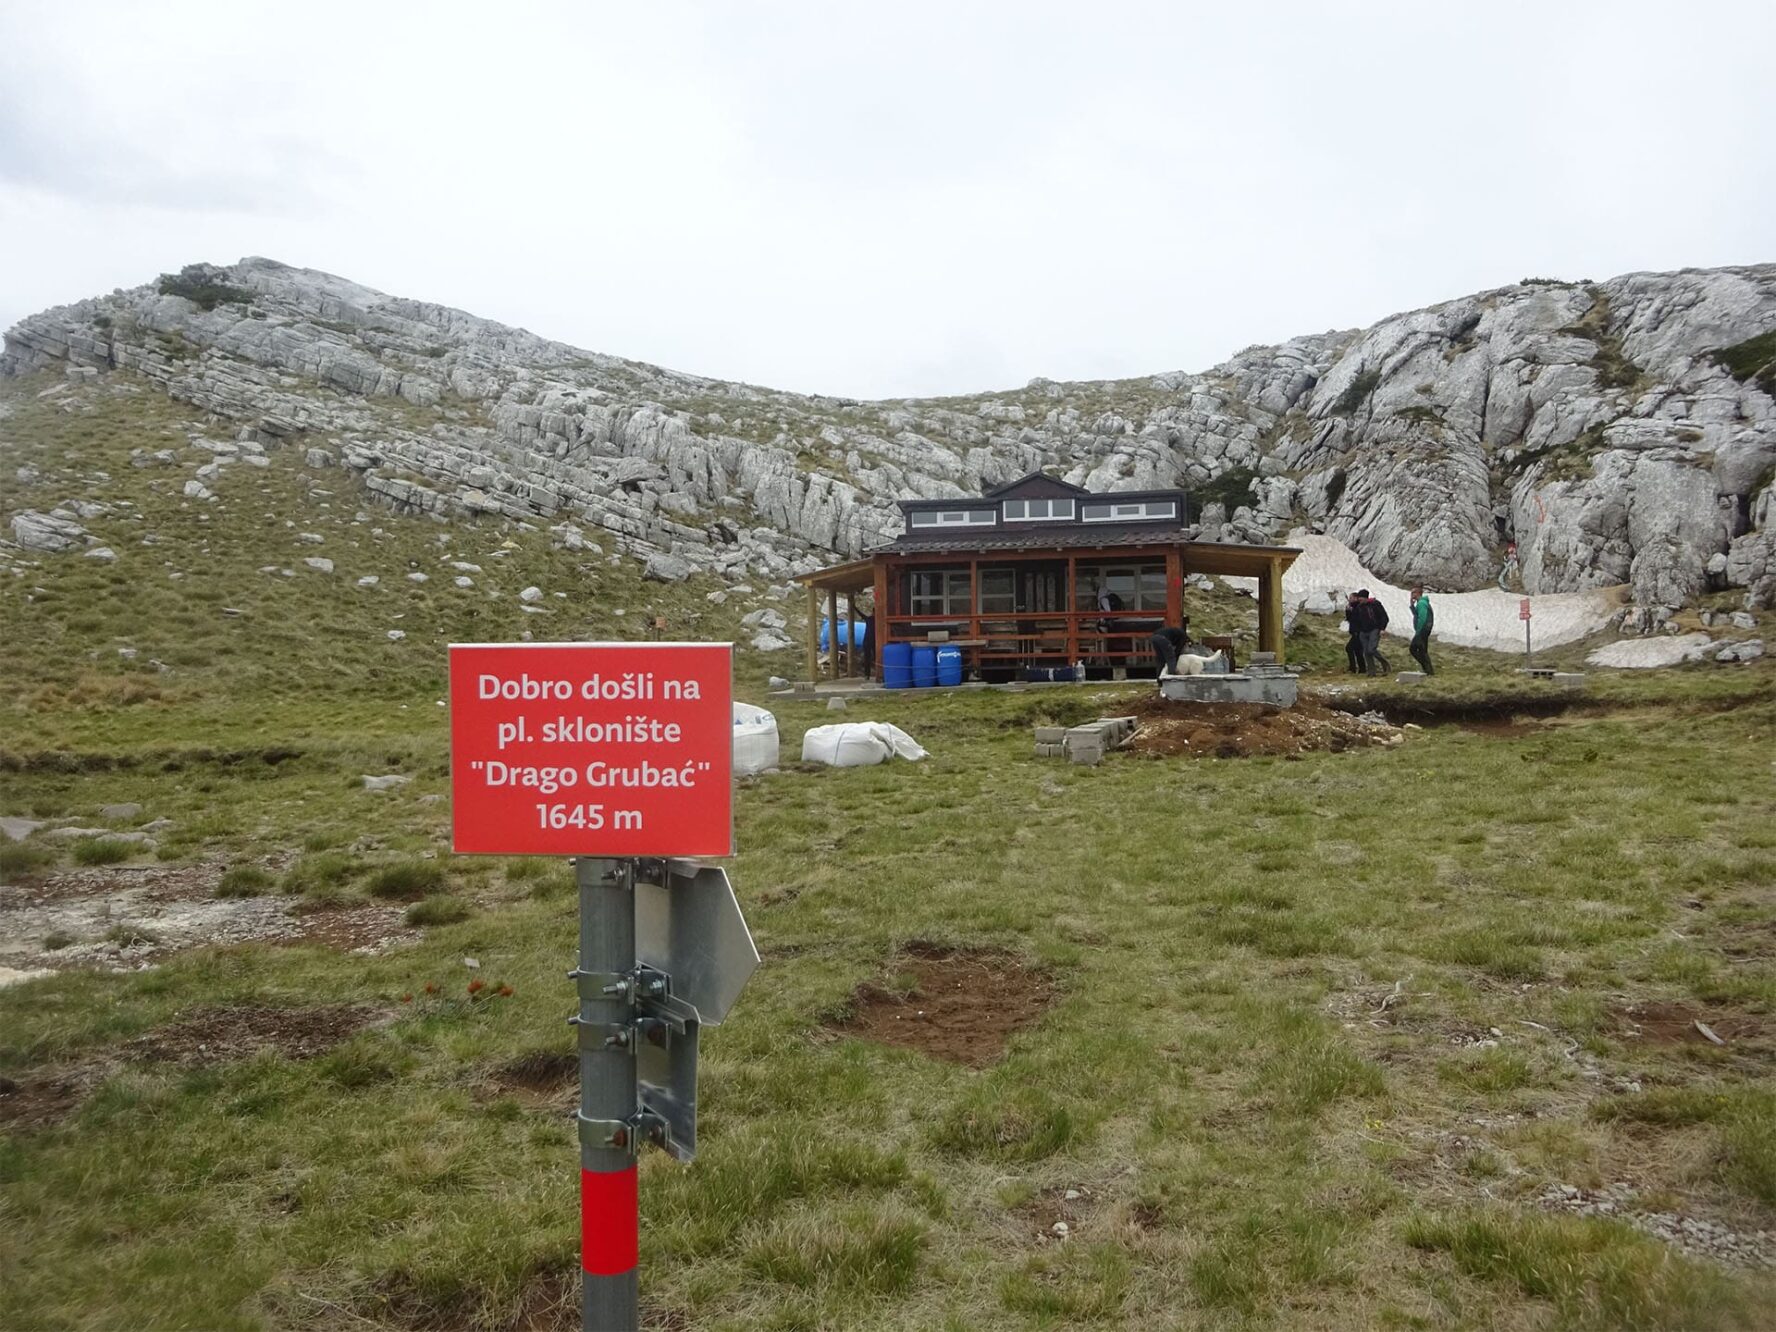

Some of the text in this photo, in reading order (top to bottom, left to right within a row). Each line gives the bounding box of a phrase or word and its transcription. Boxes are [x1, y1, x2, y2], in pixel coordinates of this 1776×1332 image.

[480, 673, 700, 699] Dobro došli na
[499, 716, 681, 749] pl. sklonište
[472, 760, 710, 794] "Drago Grubać"
[536, 804, 642, 829] 1645 m
